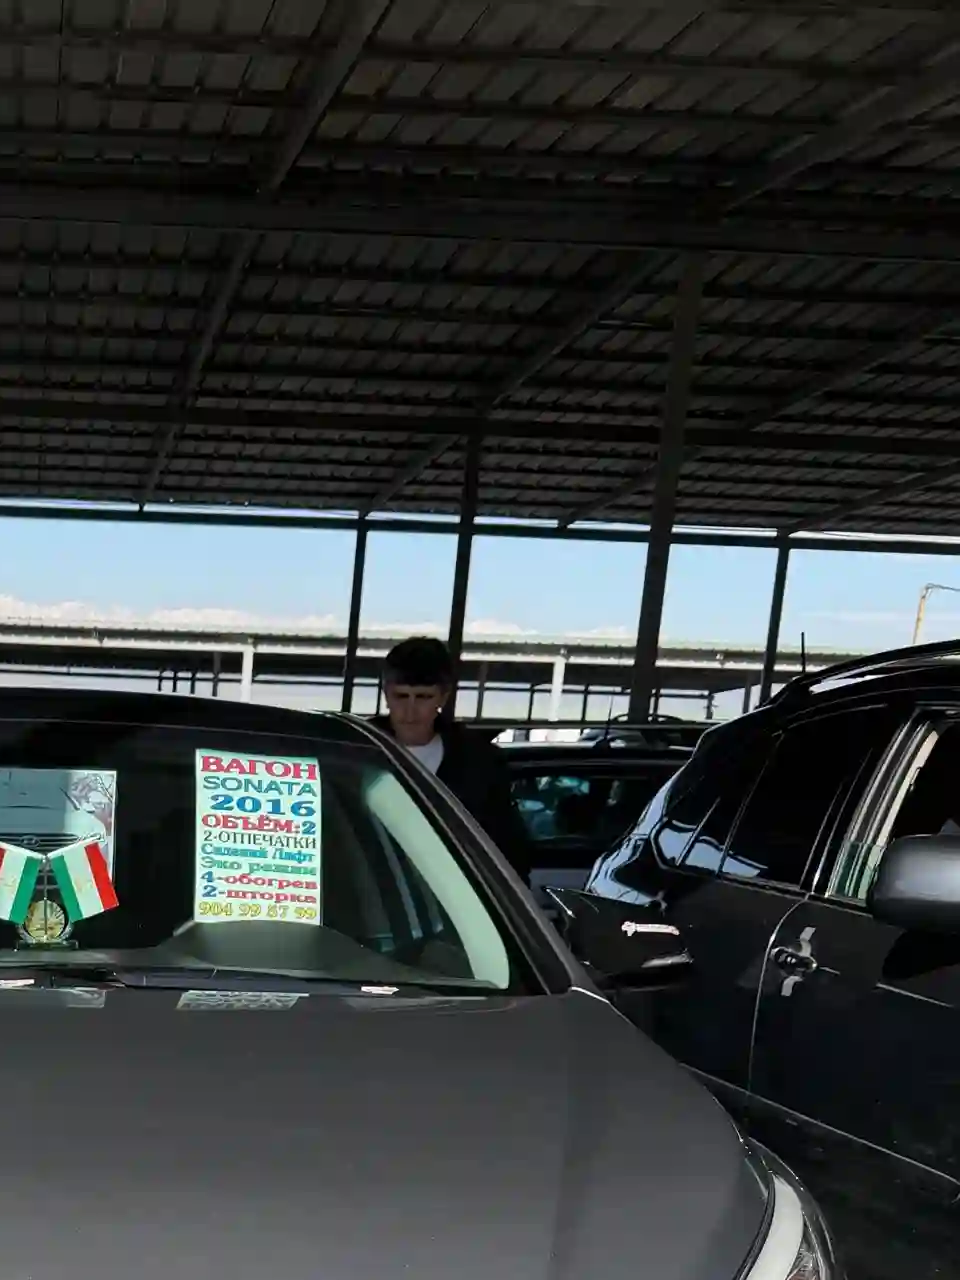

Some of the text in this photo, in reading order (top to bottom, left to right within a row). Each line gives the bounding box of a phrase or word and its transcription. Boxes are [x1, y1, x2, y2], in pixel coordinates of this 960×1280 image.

[201, 756, 317, 780] ВАГОН
[203, 776, 317, 797] SONATA
[210, 794, 316, 817] 2016
[203, 830, 316, 849] 2-ОТПЕЧАТКИ
[201, 856, 242, 870] Эко
[200, 871, 318, 890] 4-обогрев
